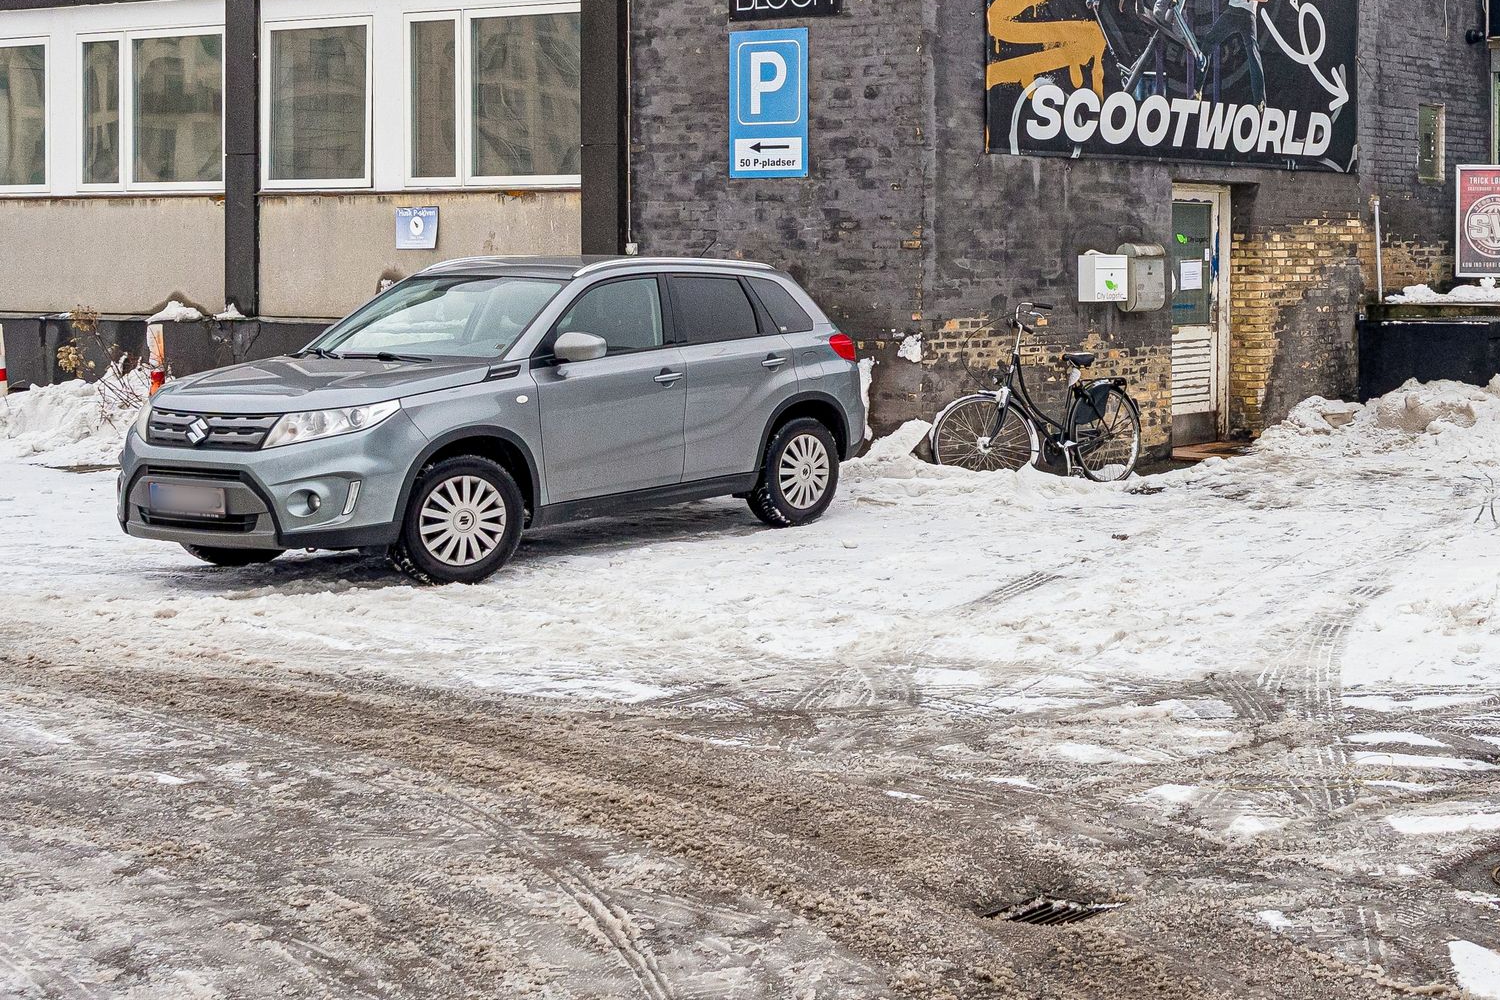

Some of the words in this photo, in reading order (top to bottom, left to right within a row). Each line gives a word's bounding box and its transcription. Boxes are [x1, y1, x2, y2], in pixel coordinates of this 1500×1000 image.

[751, 51, 787, 115] P
[1026, 84, 1332, 156] SCOOTWORLD
[740, 158, 751, 167] 50
[753, 158, 796, 168] P-pladser
